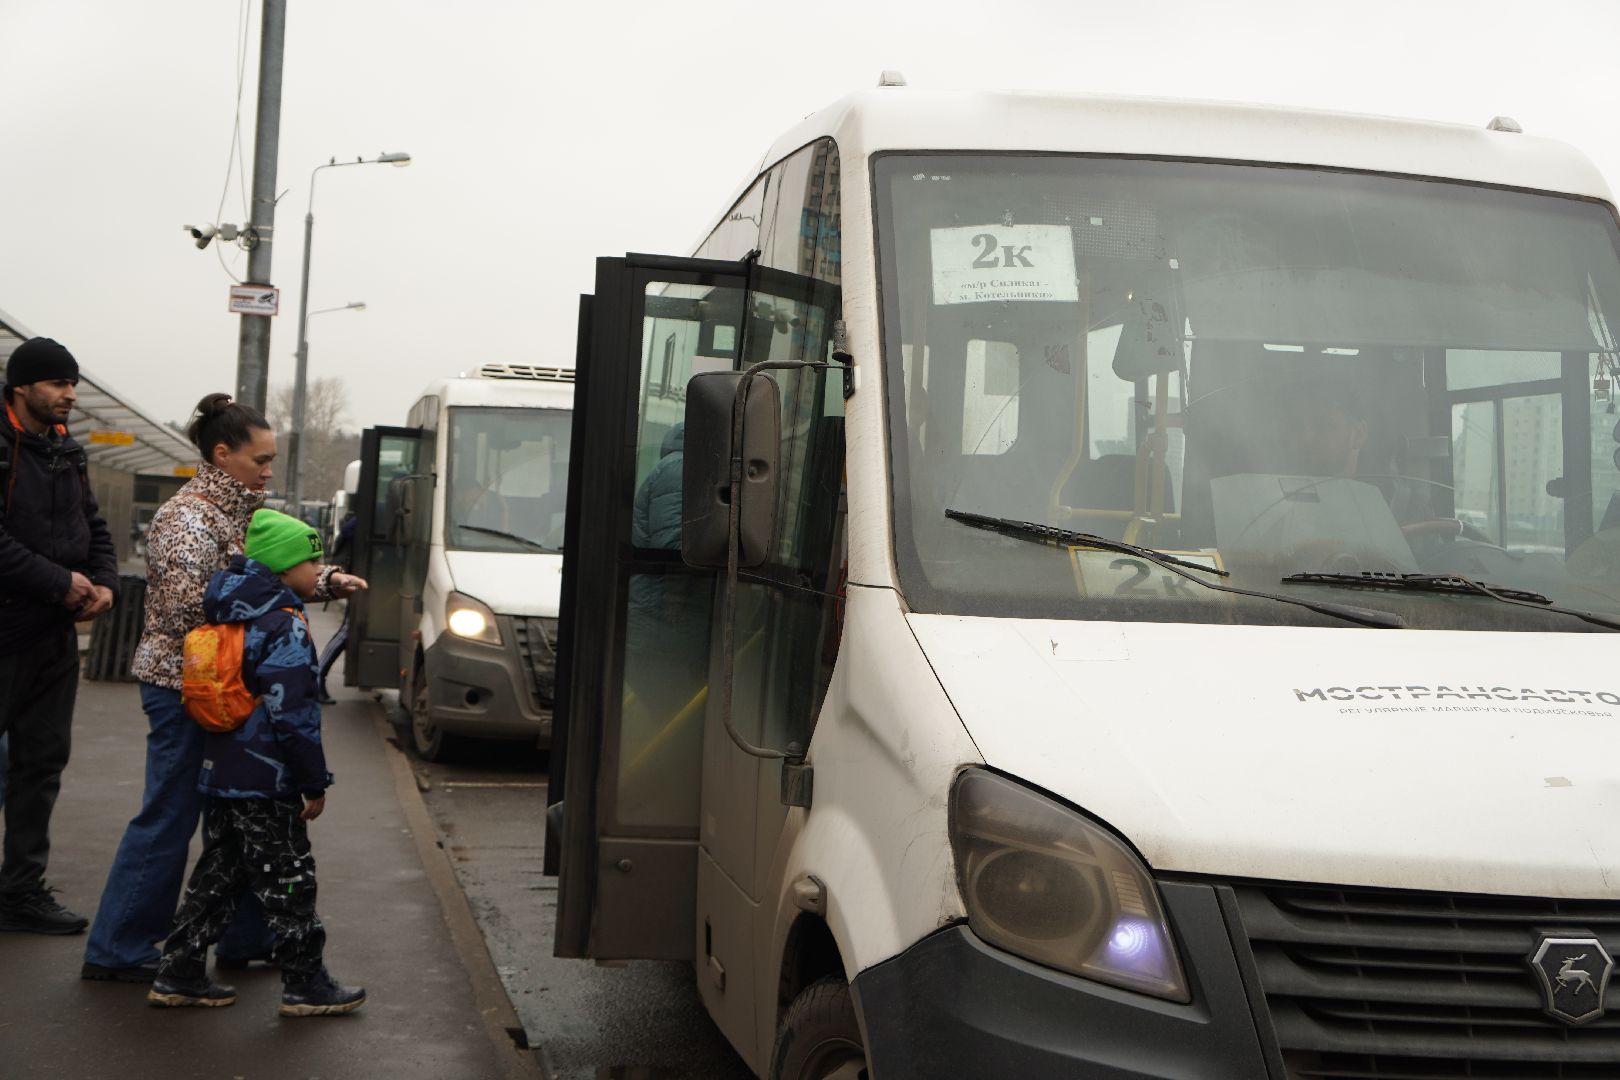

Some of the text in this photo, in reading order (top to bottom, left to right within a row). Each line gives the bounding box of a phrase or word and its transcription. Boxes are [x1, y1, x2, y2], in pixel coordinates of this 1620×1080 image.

[971, 233, 1035, 269] 2к
[990, 279, 1040, 288] Силикат
[1293, 685, 1620, 706] МОСТРАНСАВТО
[1339, 705, 1613, 718] РЕГУЛЯРНЫЕ МАРШРУТЫ ПОДМОСКОВЬЯ
